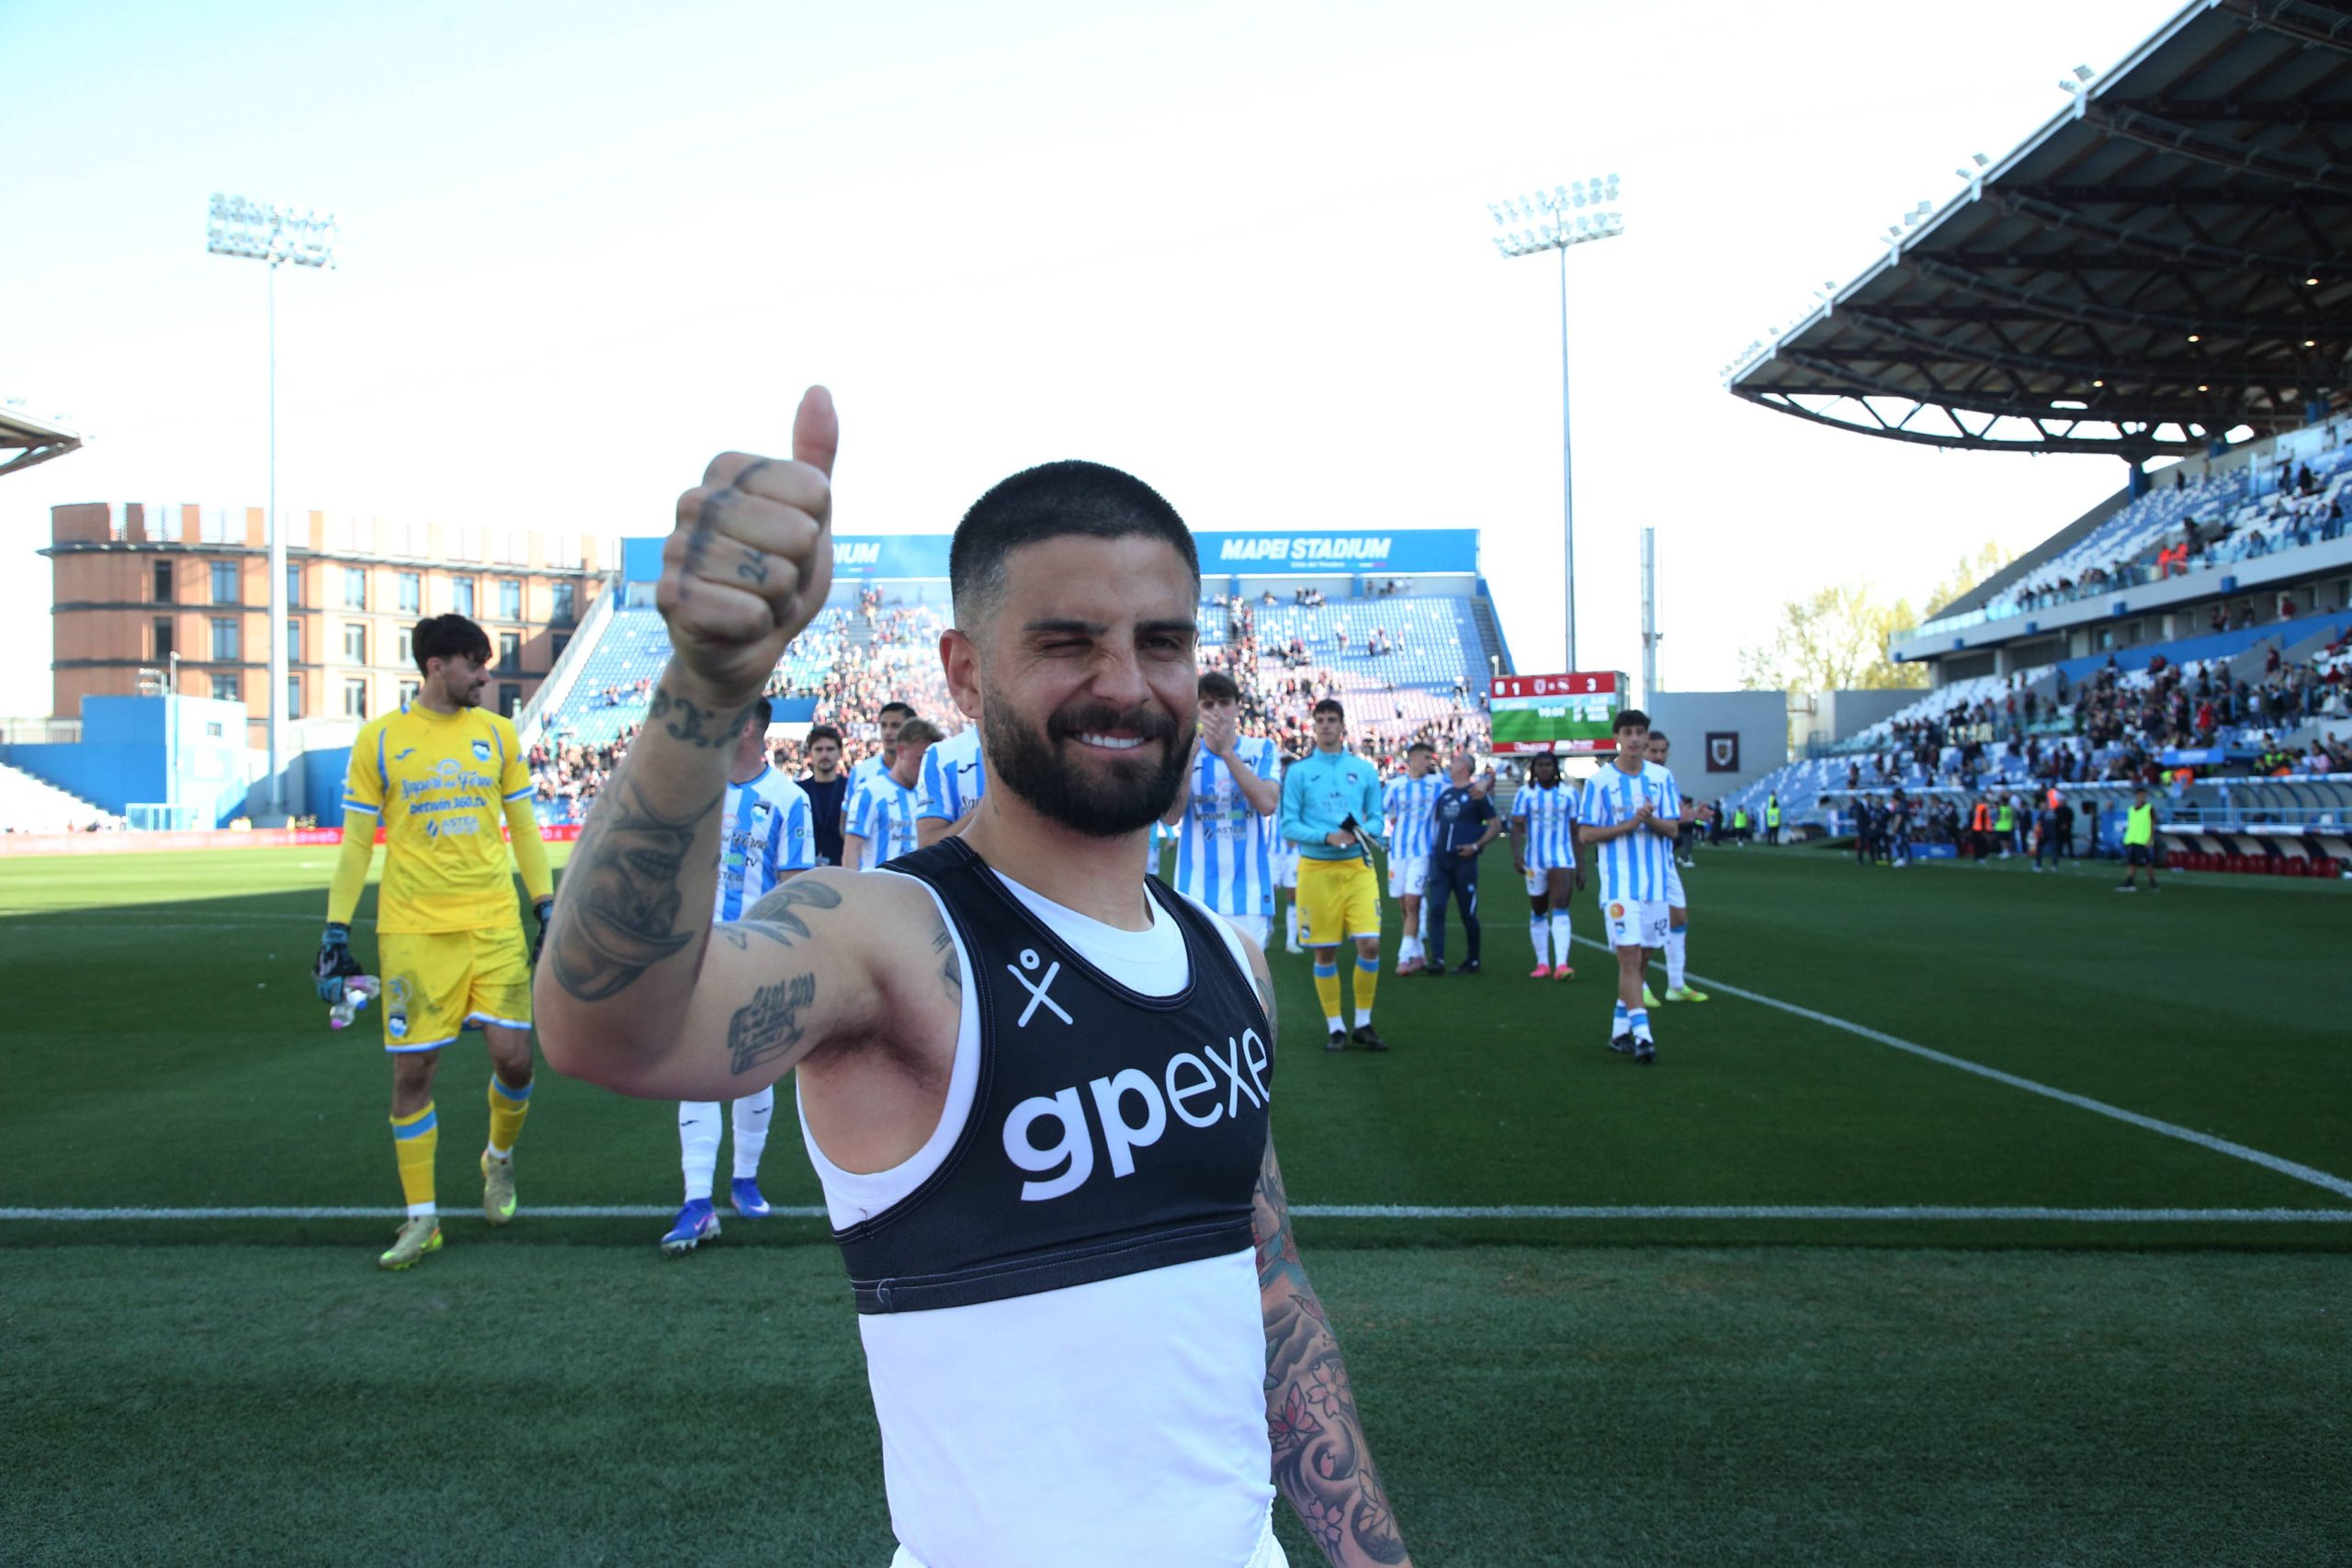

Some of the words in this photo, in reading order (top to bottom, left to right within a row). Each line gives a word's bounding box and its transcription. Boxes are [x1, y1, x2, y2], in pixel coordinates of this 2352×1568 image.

[1220, 538, 1290, 559] MAPEI
[1291, 537, 1392, 559] STADIUM
[1511, 682, 1521, 696] 1
[1587, 678, 1597, 692] 3
[1002, 1027, 1271, 1201] gpexe
